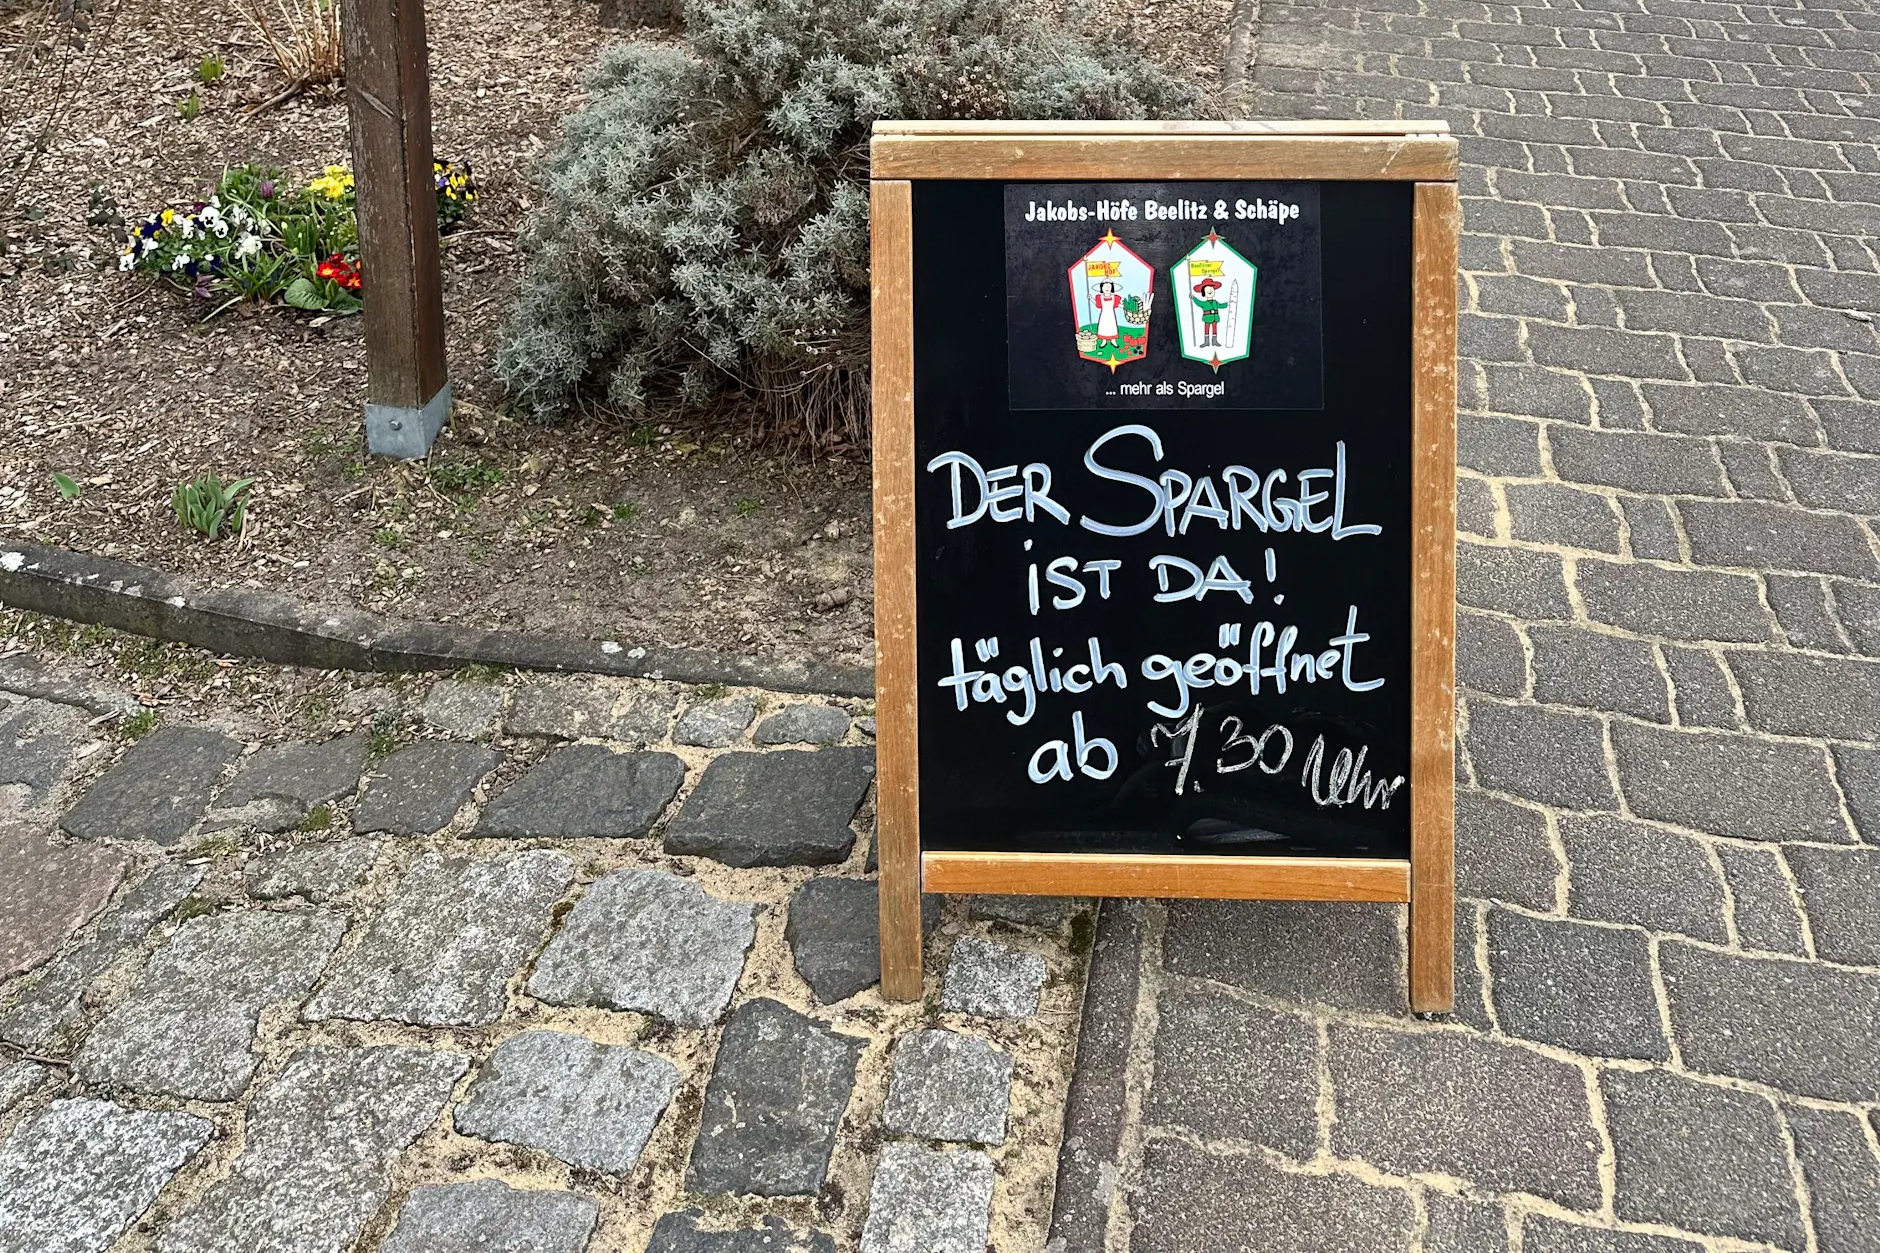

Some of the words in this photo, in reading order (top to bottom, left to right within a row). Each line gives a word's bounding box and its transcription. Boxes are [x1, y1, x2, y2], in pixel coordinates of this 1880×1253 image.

[1024, 200, 1138, 222] Jakobs-Höfe
[1144, 199, 1208, 221] Beelitz
[1213, 199, 1230, 220] &
[1234, 198, 1300, 226] Schäpe
[1120, 381, 1153, 395] mehr
[1155, 381, 1174, 395] als
[1177, 381, 1225, 399] Spargel
[927, 450, 1071, 530] DER
[1080, 424, 1383, 542] SPARGEL
[937, 637, 1128, 726] täglich
[1141, 605, 1386, 718] geöffnet
[1027, 710, 1119, 784] ab
[1301, 733, 1405, 810] Uhr
